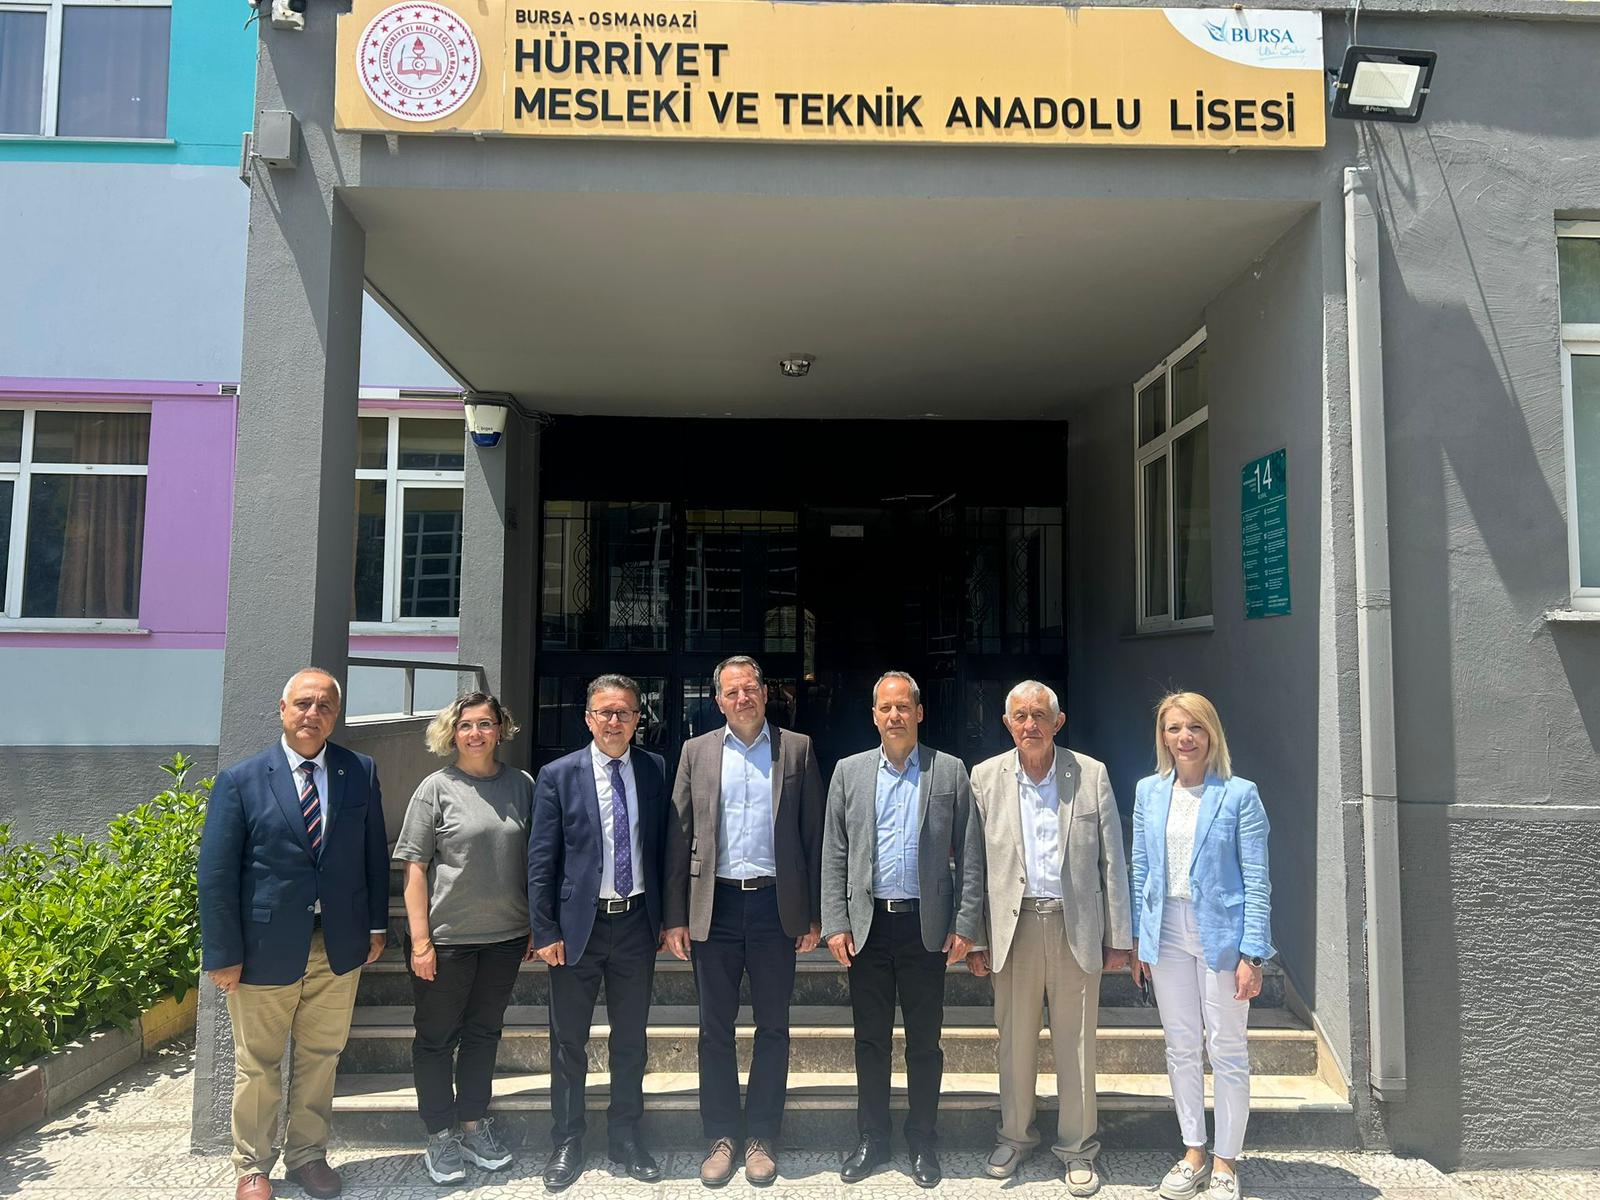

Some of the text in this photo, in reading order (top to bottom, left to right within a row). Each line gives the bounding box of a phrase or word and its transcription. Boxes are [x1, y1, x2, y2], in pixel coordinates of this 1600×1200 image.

[515, 9, 574, 25] BURSA
[589, 10, 697, 28] OSMANGAZİ
[382, 25, 456, 96] TÜRKİYE CUMHURİYETİ MİLLİ EĞİTİM BAKANLIĞI
[515, 31, 728, 77] HÜRRİYET
[514, 83, 1295, 132] MESLEKİ VE TEKNİK ANADOLU LİSESİ
[1254, 459, 1273, 494] 14
